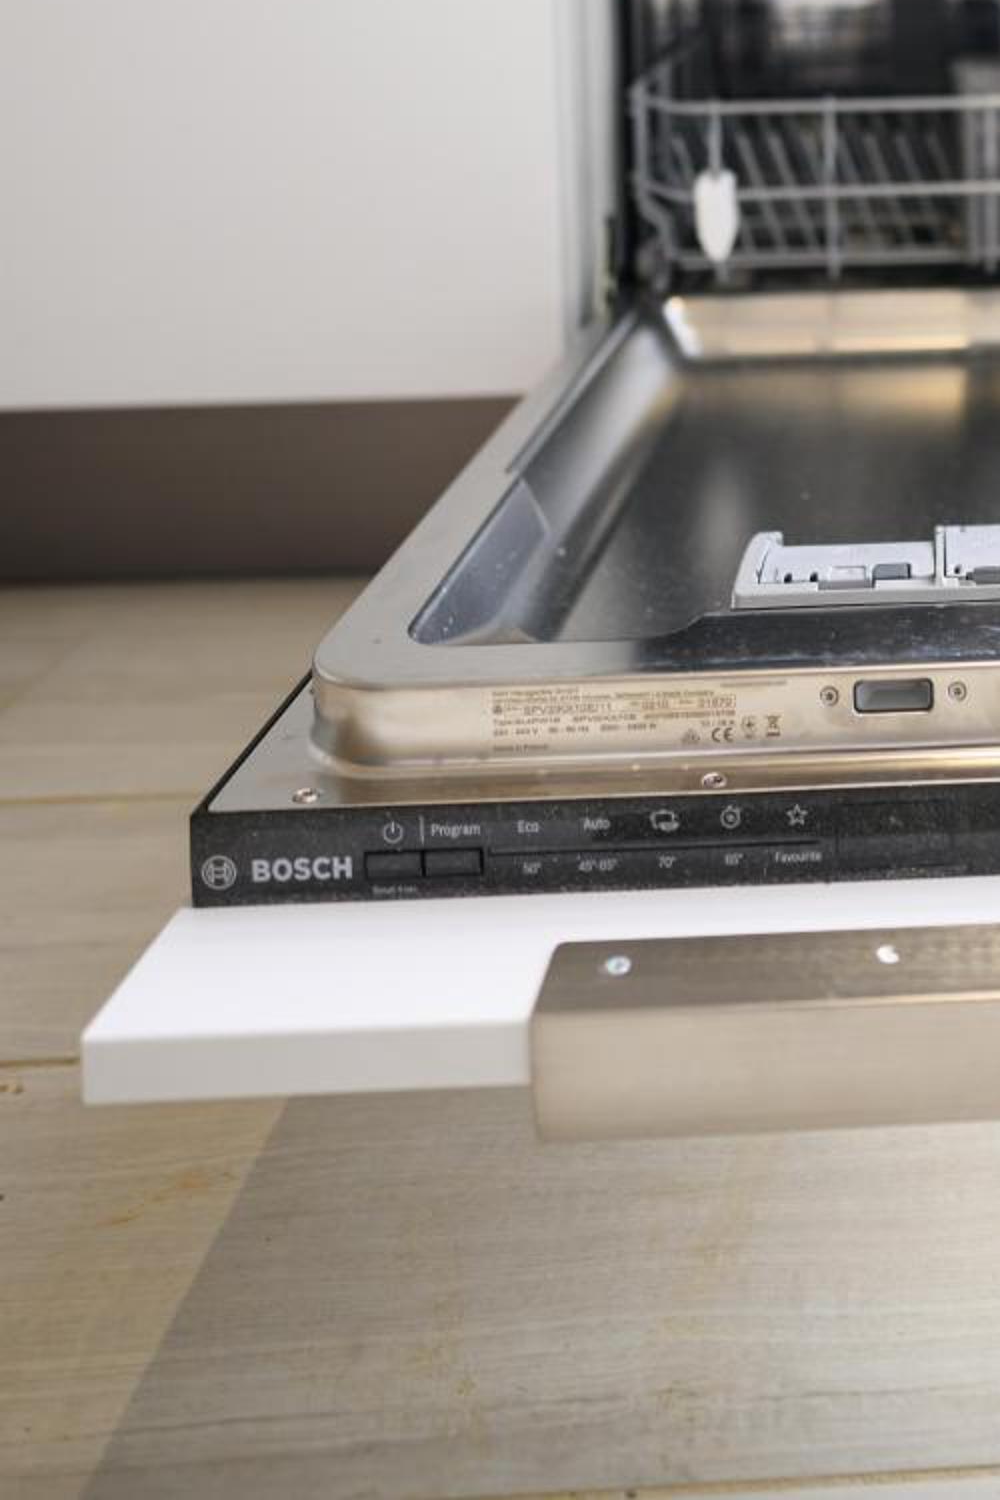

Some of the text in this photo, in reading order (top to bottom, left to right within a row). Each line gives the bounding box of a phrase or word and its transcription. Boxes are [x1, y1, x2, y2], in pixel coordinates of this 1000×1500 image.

[430, 822, 481, 839] Program
[517, 819, 541, 834] Eco
[583, 817, 611, 831] Auto
[658, 855, 677, 869] 70°
[774, 850, 823, 864] Favourite
[251, 856, 353, 882] BOSCH
